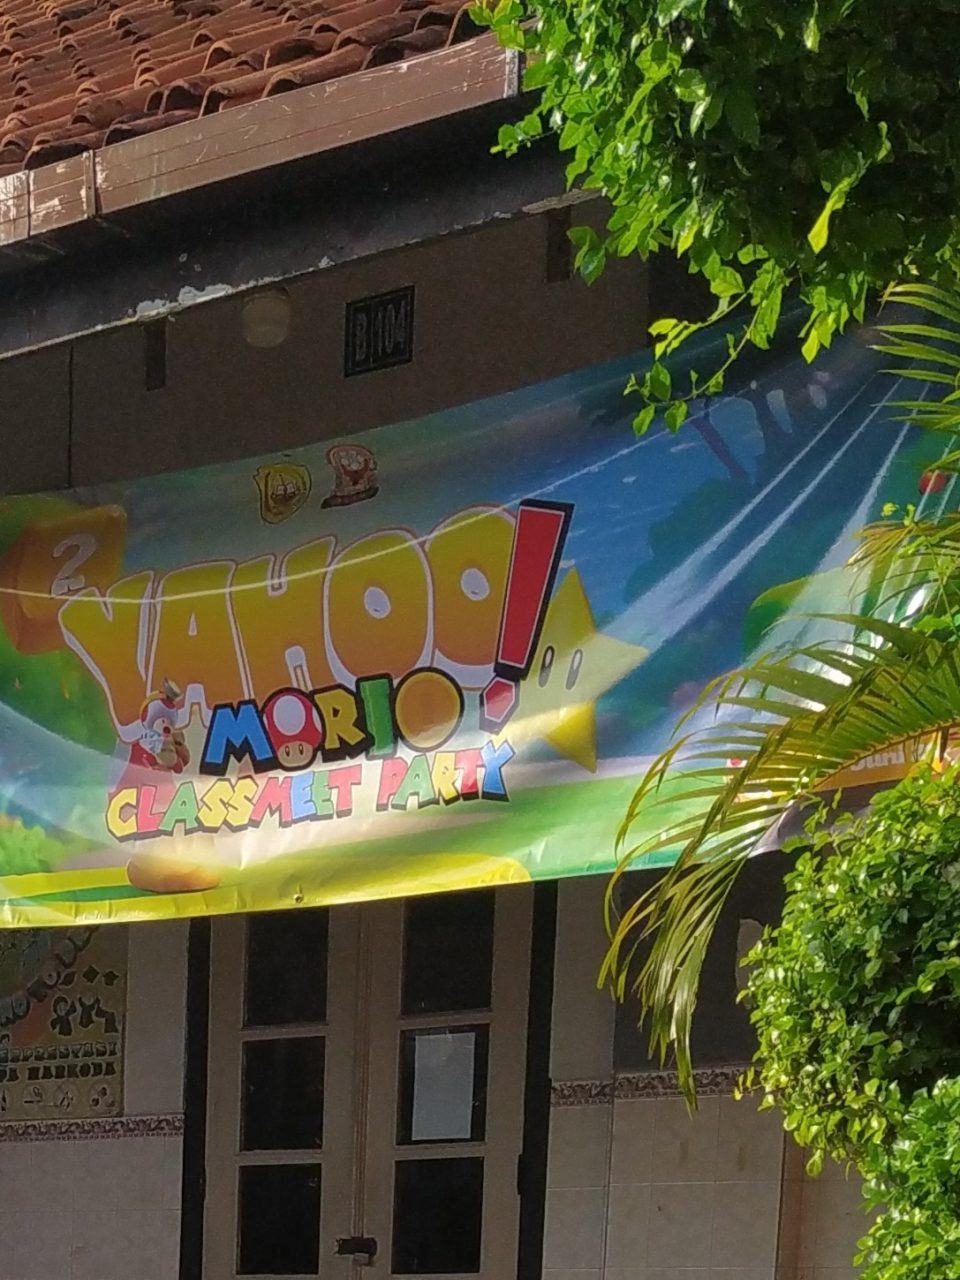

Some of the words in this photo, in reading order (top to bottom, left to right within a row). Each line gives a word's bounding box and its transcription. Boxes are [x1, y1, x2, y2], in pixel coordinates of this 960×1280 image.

[58, 499, 575, 744] YAHOO!
[106, 768, 361, 842] CLASSMEET
[377, 741, 515, 812] PARTY
